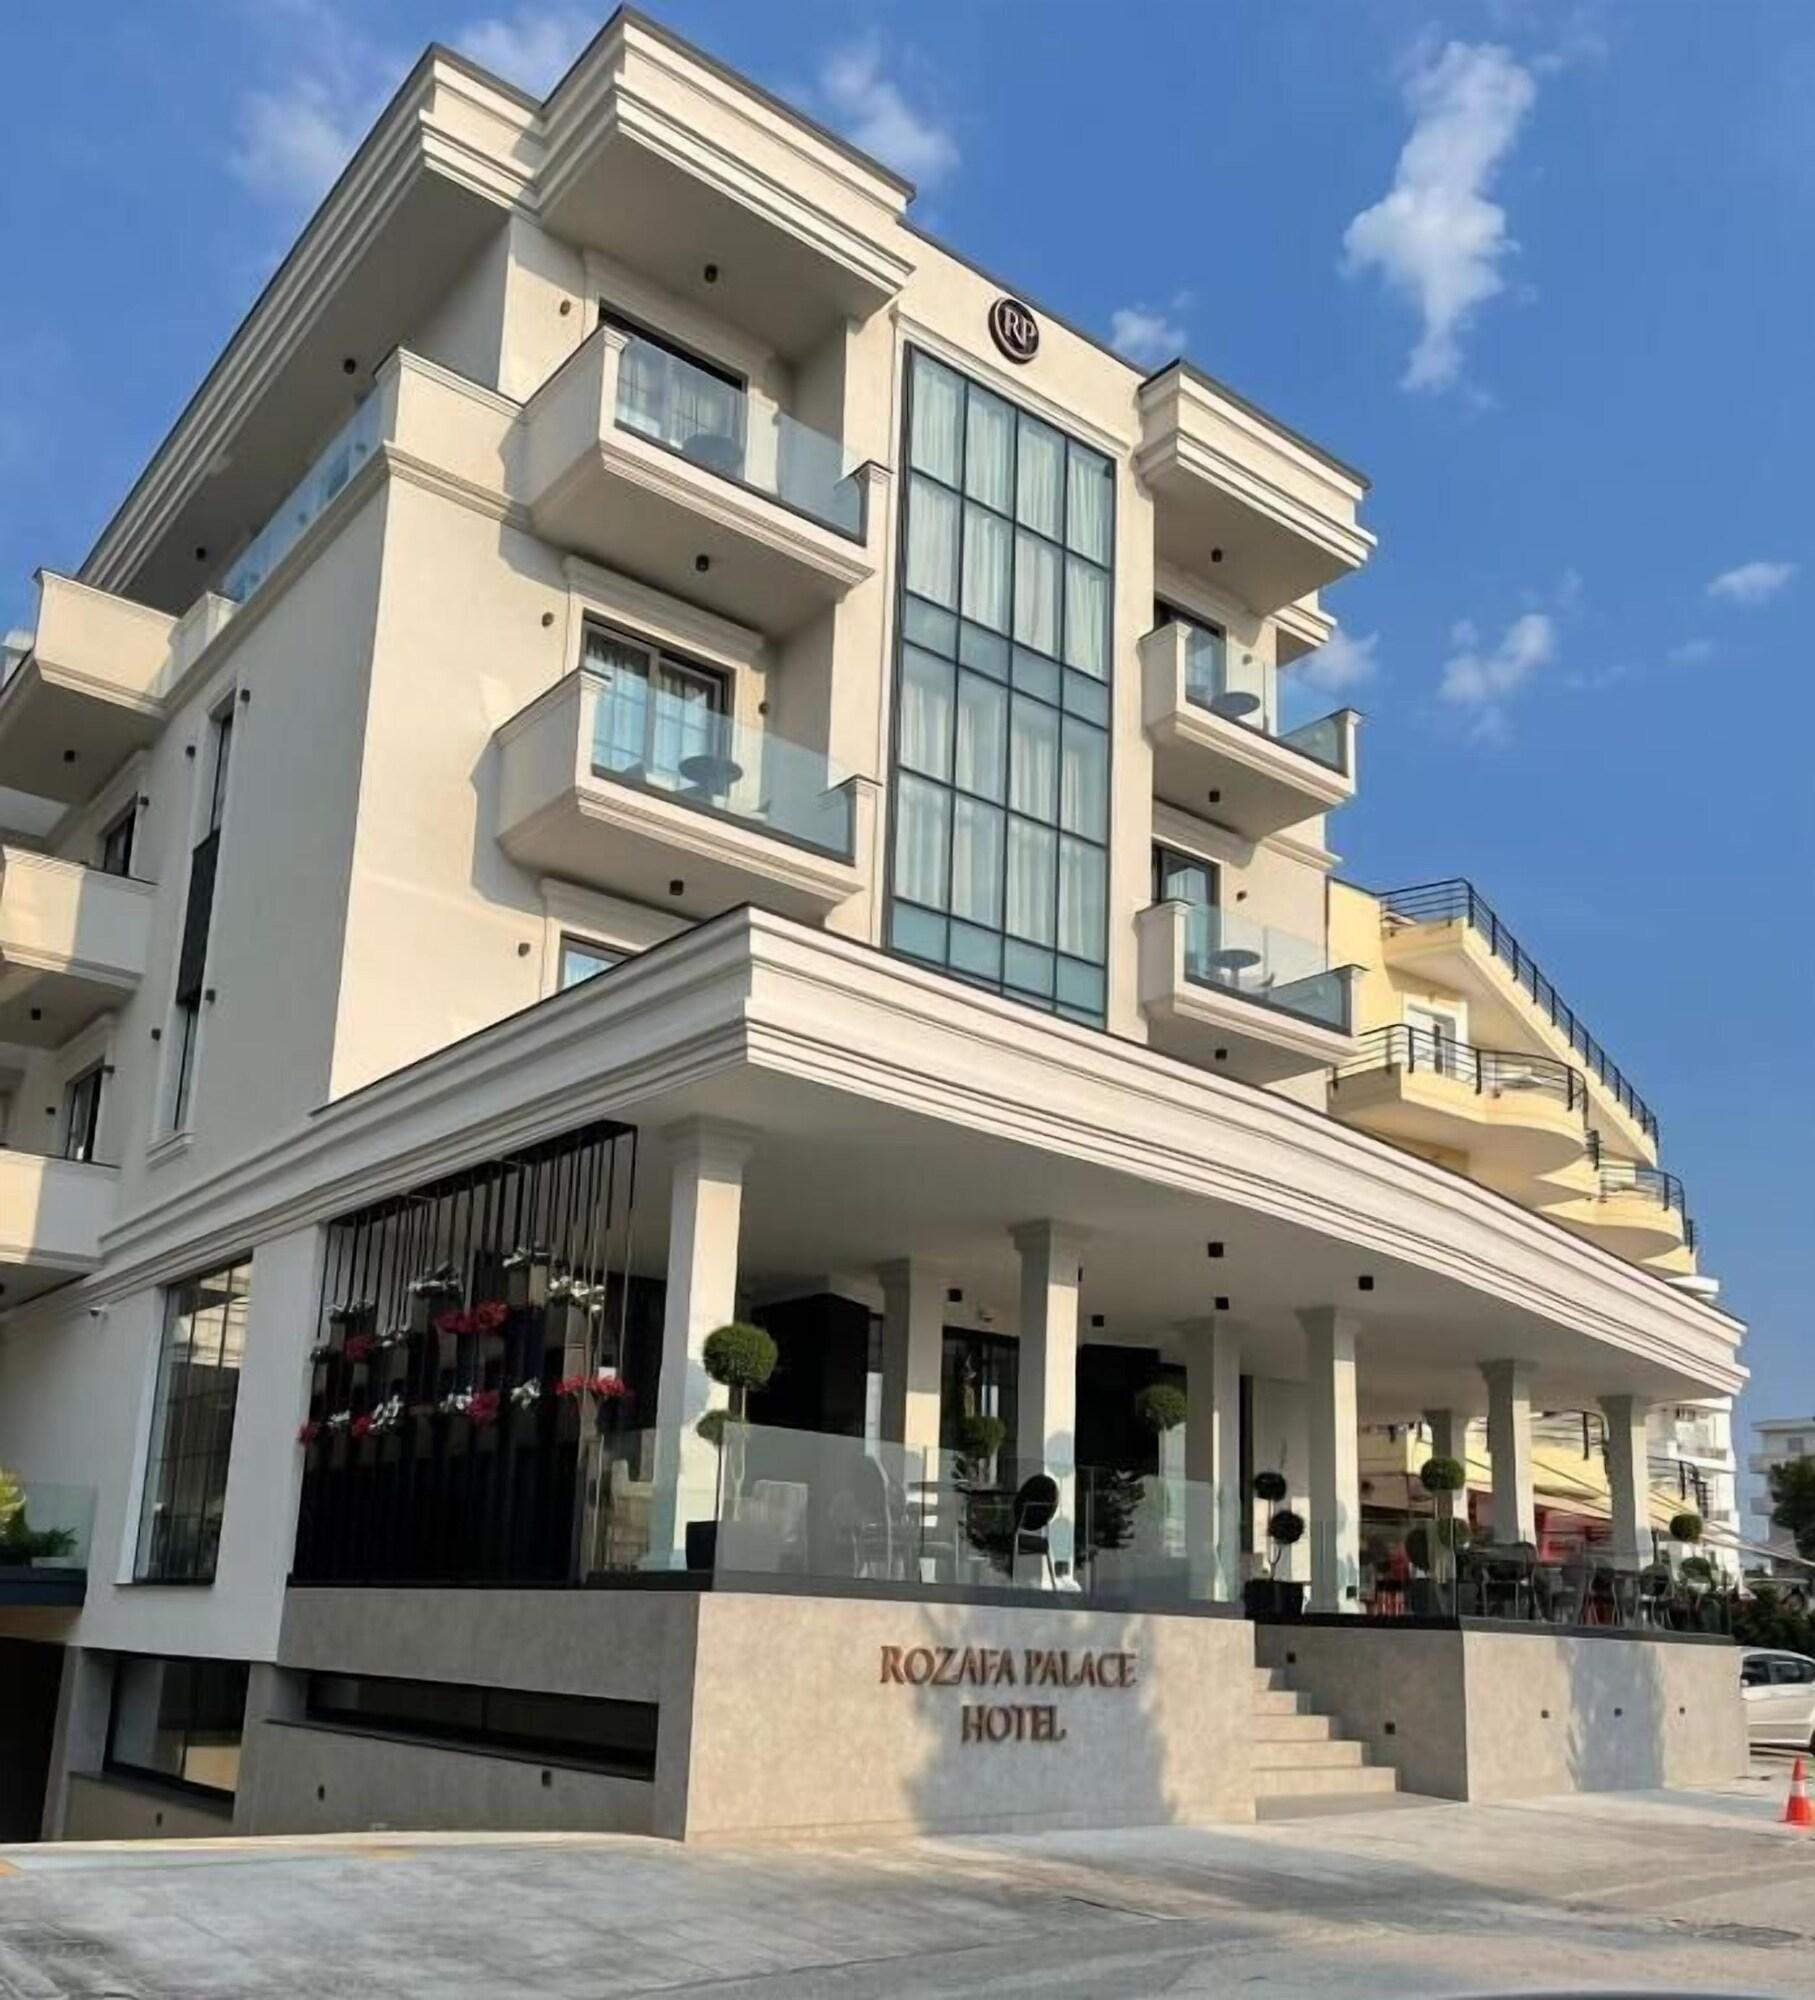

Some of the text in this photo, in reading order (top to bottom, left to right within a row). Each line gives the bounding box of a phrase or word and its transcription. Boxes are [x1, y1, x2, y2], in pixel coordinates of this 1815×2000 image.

[1002, 304, 1038, 346] RP
[880, 1646, 1137, 1687] ROZAFA PALACE
[961, 1704, 1066, 1743] HOTEL
